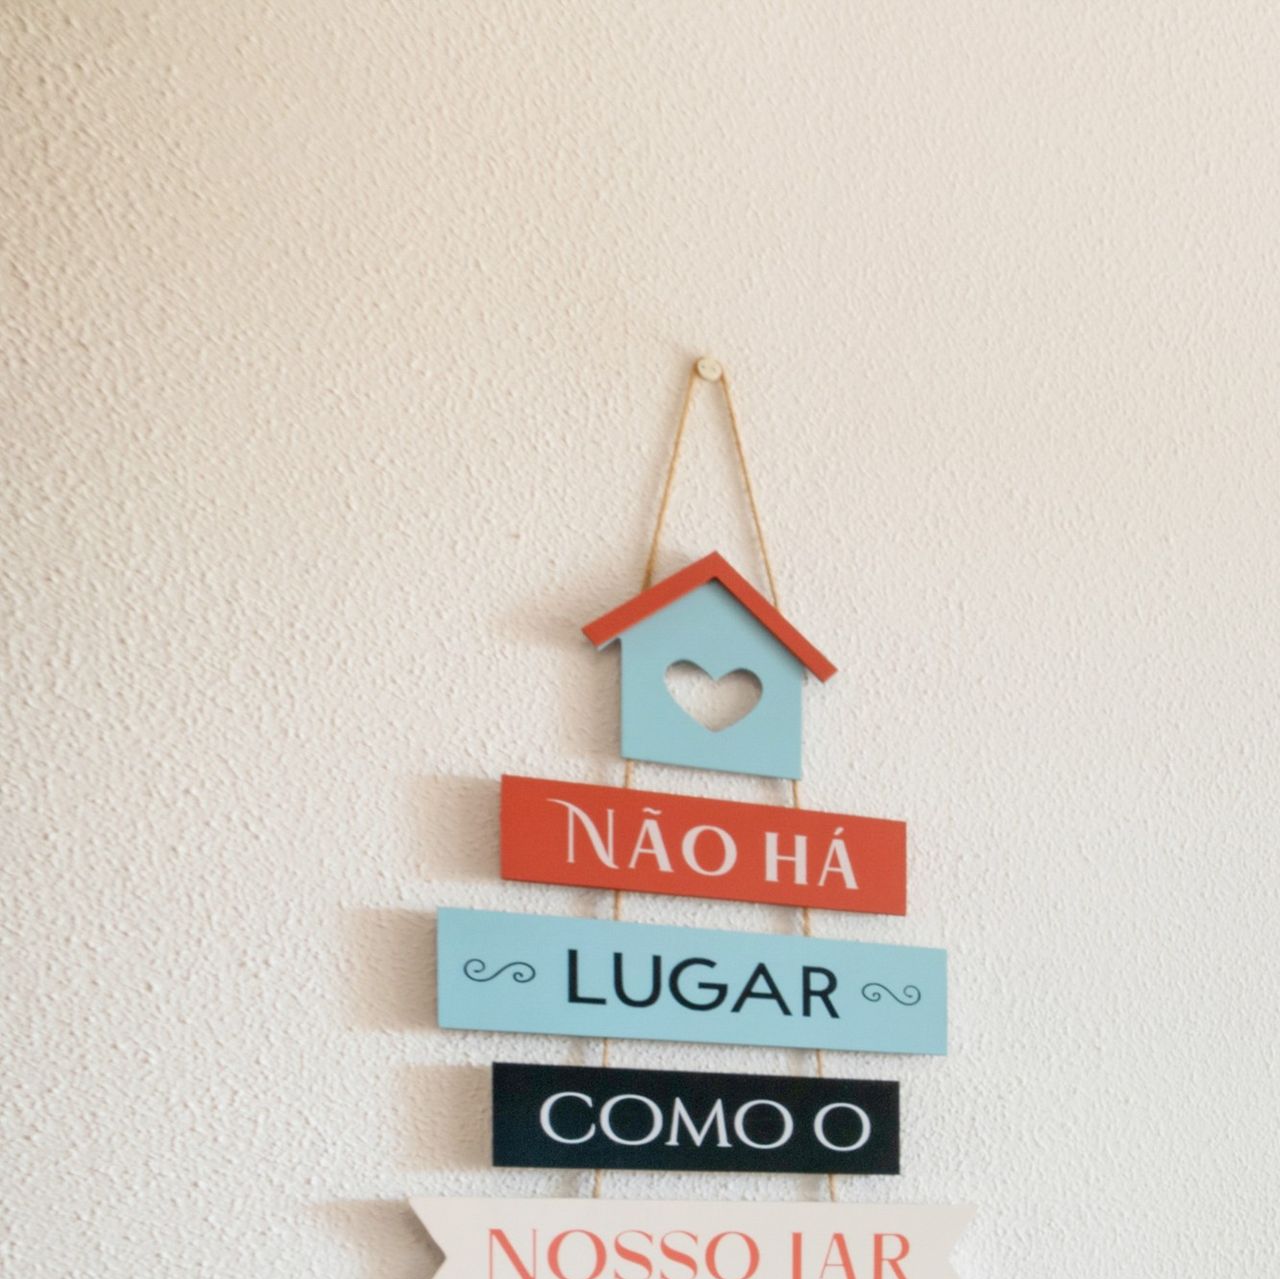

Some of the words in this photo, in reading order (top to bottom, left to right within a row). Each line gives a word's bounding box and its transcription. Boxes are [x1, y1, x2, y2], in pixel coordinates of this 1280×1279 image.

[546, 797, 738, 878] NÃO
[763, 826, 859, 890] HÁ
[566, 948, 841, 1020] LUGAR
[539, 1091, 794, 1150] COMO
[813, 1102, 872, 1152] O
